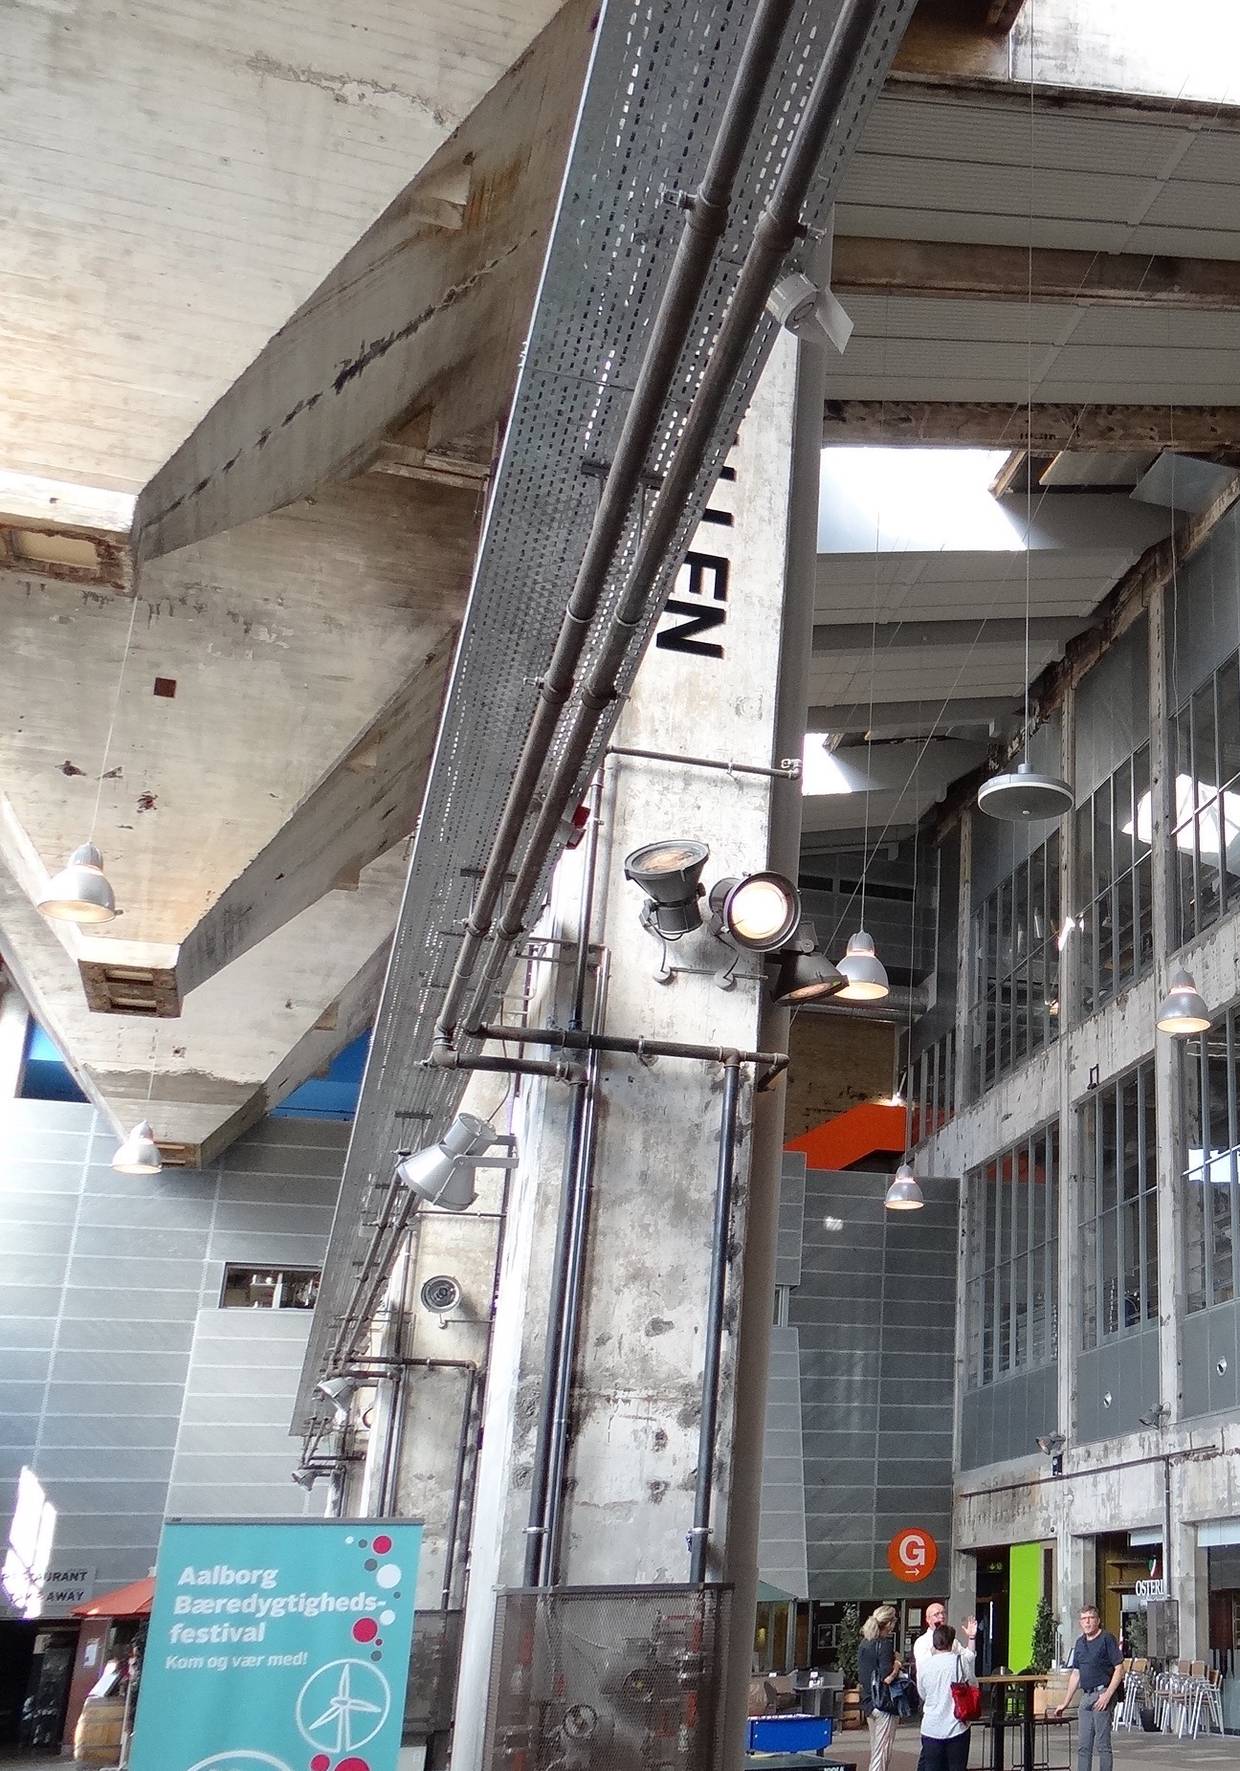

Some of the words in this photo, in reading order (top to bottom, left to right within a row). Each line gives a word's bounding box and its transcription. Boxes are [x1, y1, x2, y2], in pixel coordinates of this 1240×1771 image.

[899, 1535, 926, 1567] G
[177, 1565, 279, 1589] Aalborg
[173, 1592, 386, 1617] Bæredygtigheds-
[169, 1621, 266, 1644] festival
[165, 1655, 204, 1670] Kom
[207, 1656, 228, 1672] og
[232, 1655, 265, 1668] vær
[267, 1652, 309, 1667] med!
